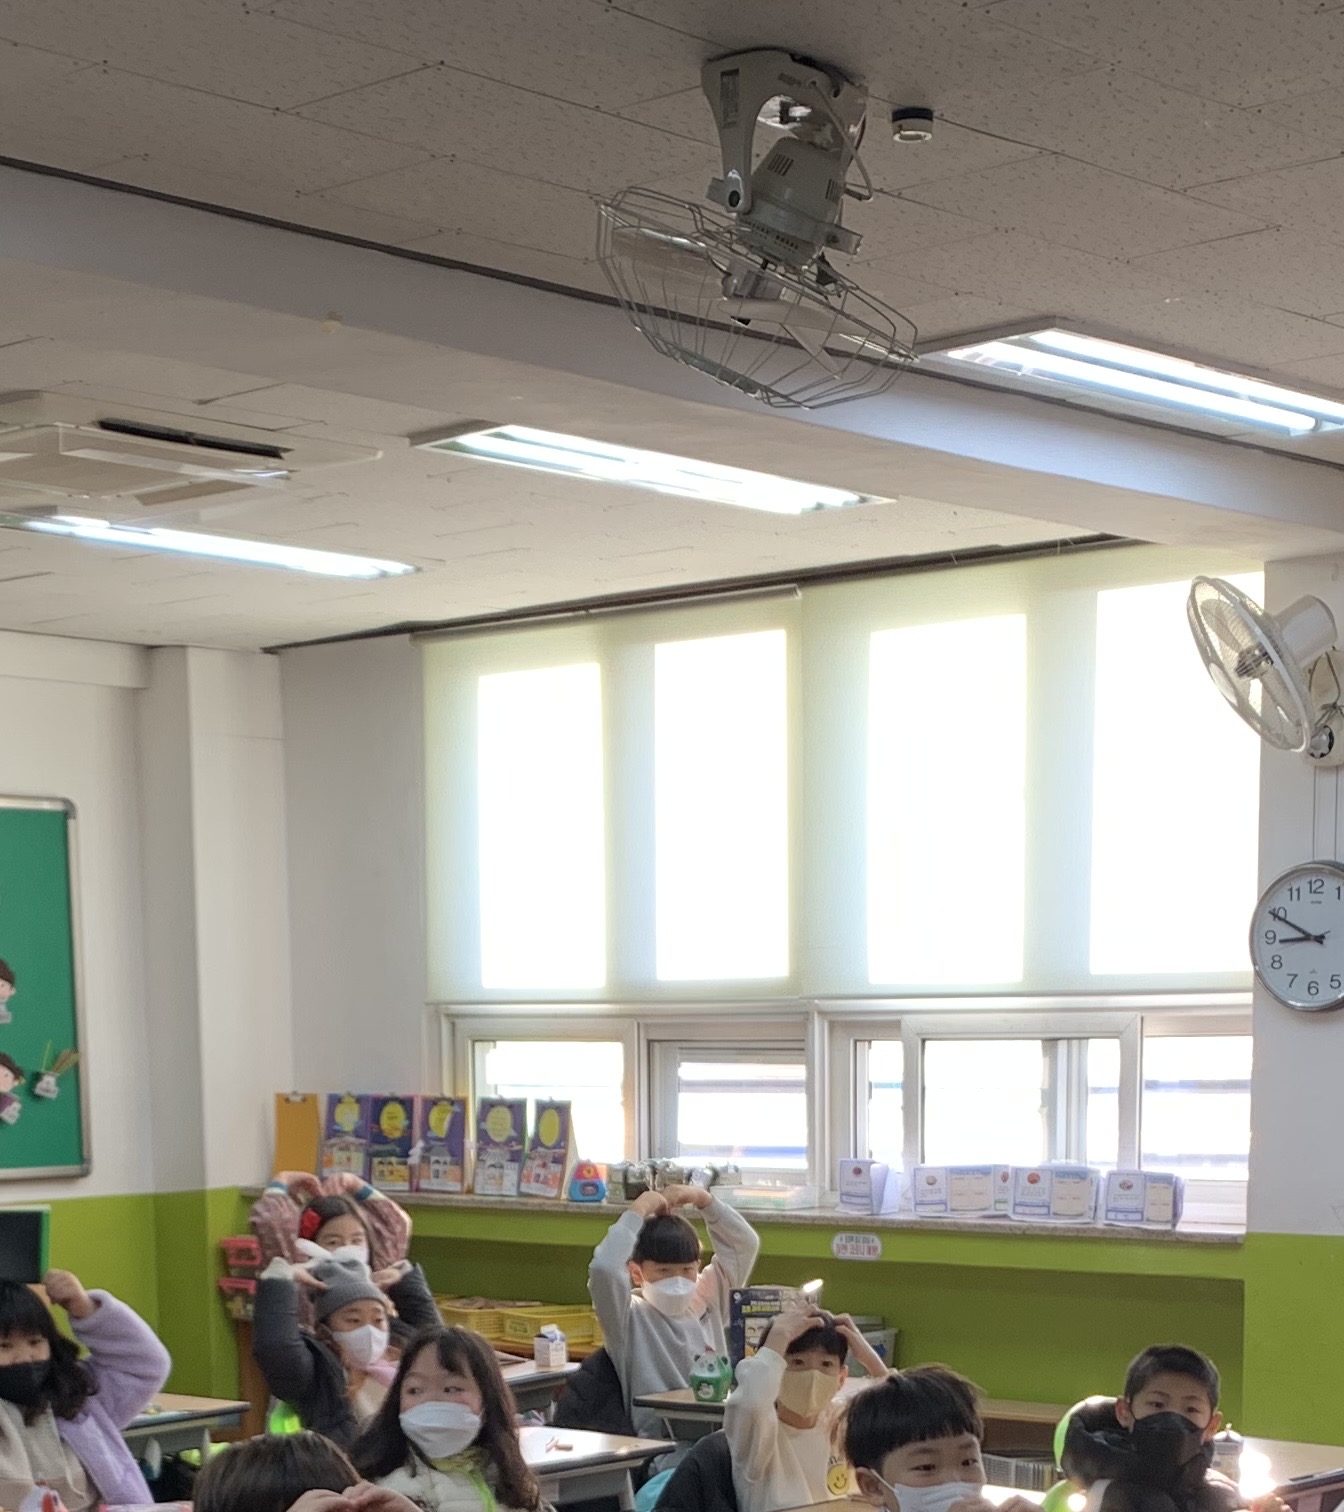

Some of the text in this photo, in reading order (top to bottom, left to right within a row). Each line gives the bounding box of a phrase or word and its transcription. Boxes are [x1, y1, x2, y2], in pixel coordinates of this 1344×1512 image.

[1287, 886, 1301, 902] 11
[1308, 878, 1325, 895] 12
[1335, 885, 1341, 901] 1
[1271, 906, 1288, 922] 10
[1264, 929, 1277, 945] 9
[1270, 954, 1283, 970] 8
[1286, 973, 1298, 989] 7
[1307, 980, 1319, 996] 6
[1329, 973, 1342, 990] 5
